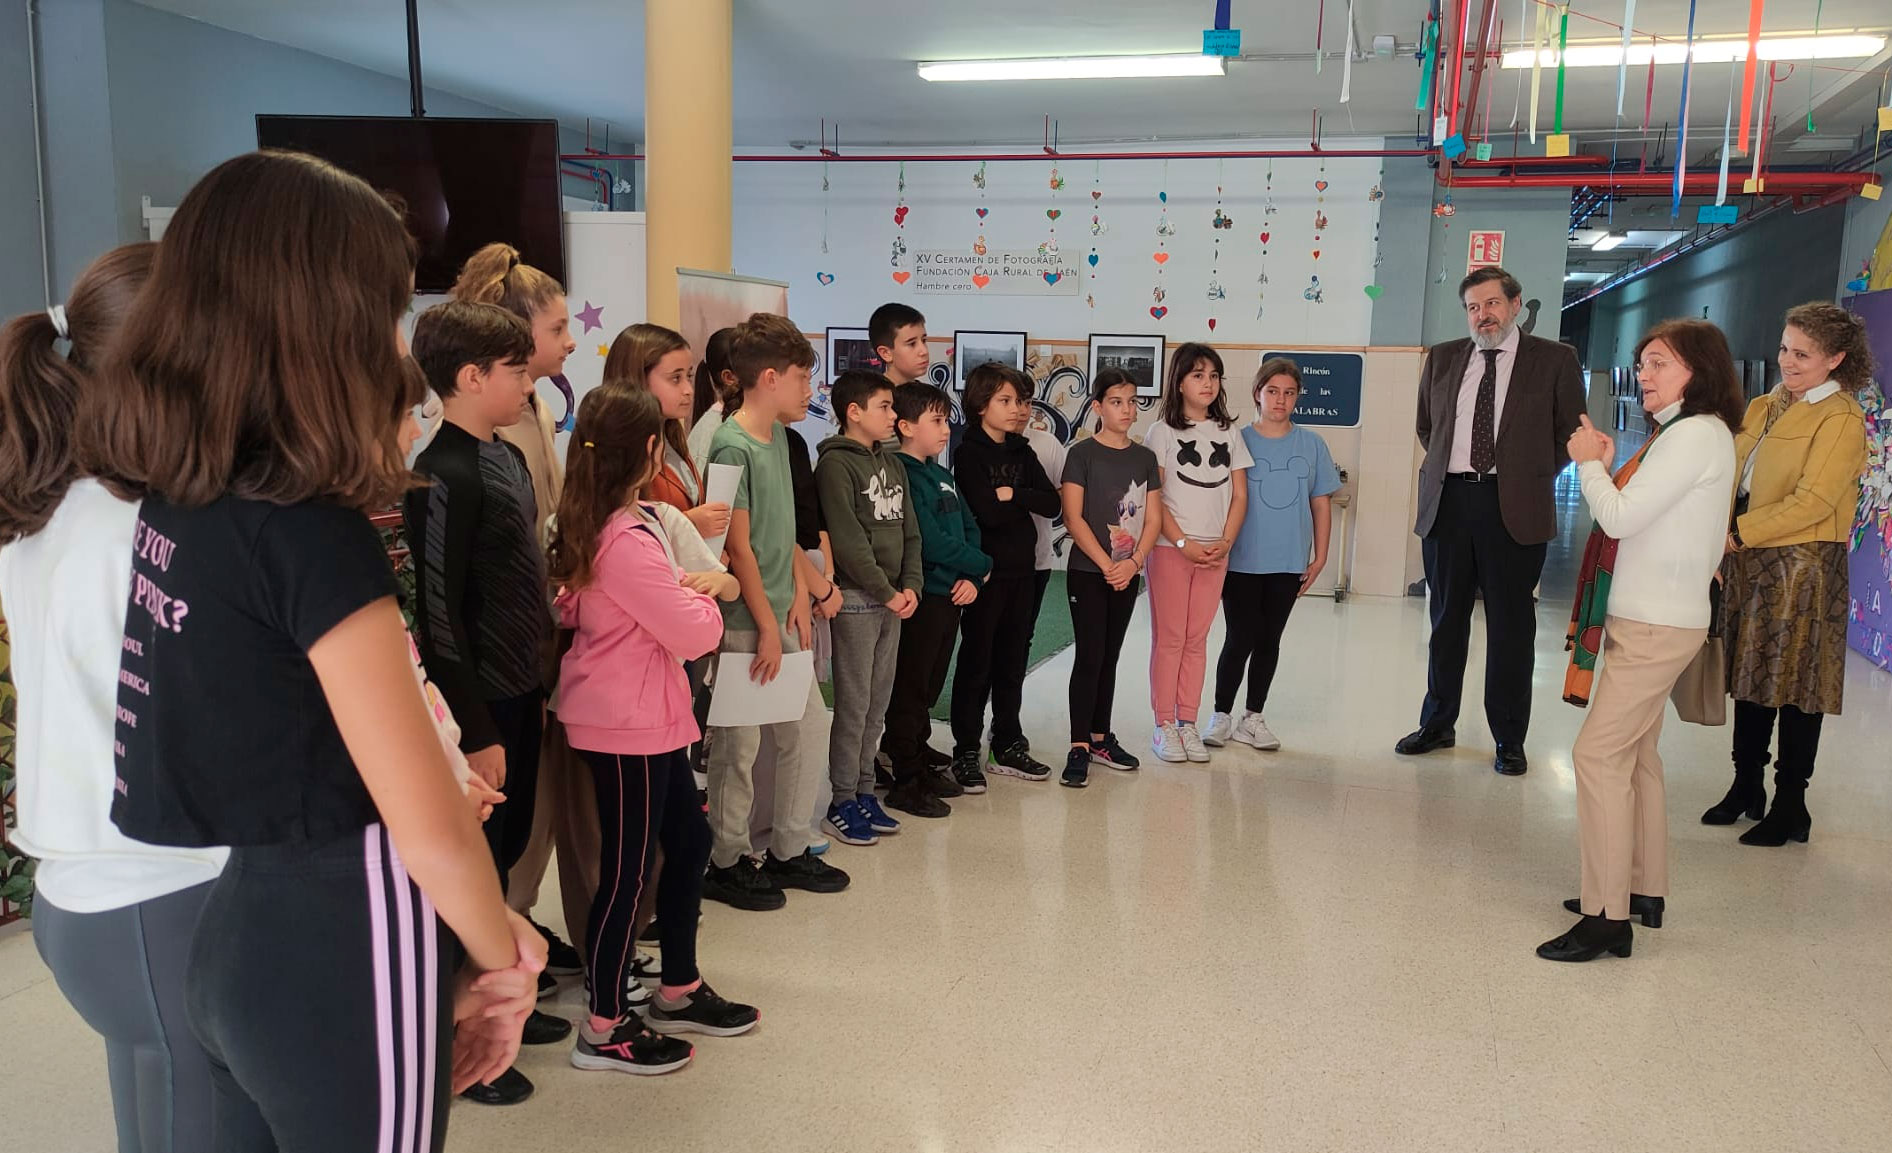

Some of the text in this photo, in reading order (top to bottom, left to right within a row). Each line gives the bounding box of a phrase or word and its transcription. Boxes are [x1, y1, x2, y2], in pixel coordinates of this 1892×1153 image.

[916, 254, 931, 264] XV
[935, 254, 984, 264] CERTAMEN
[988, 256, 999, 264] DE
[916, 265, 970, 276] FUNDACIÓN
[974, 265, 999, 276] CAJA
[1003, 266, 1033, 276] RURAL
[916, 282, 972, 291] Hambre cero
[1293, 406, 1339, 416] ALABRAS
[140, 526, 176, 572] YOU
